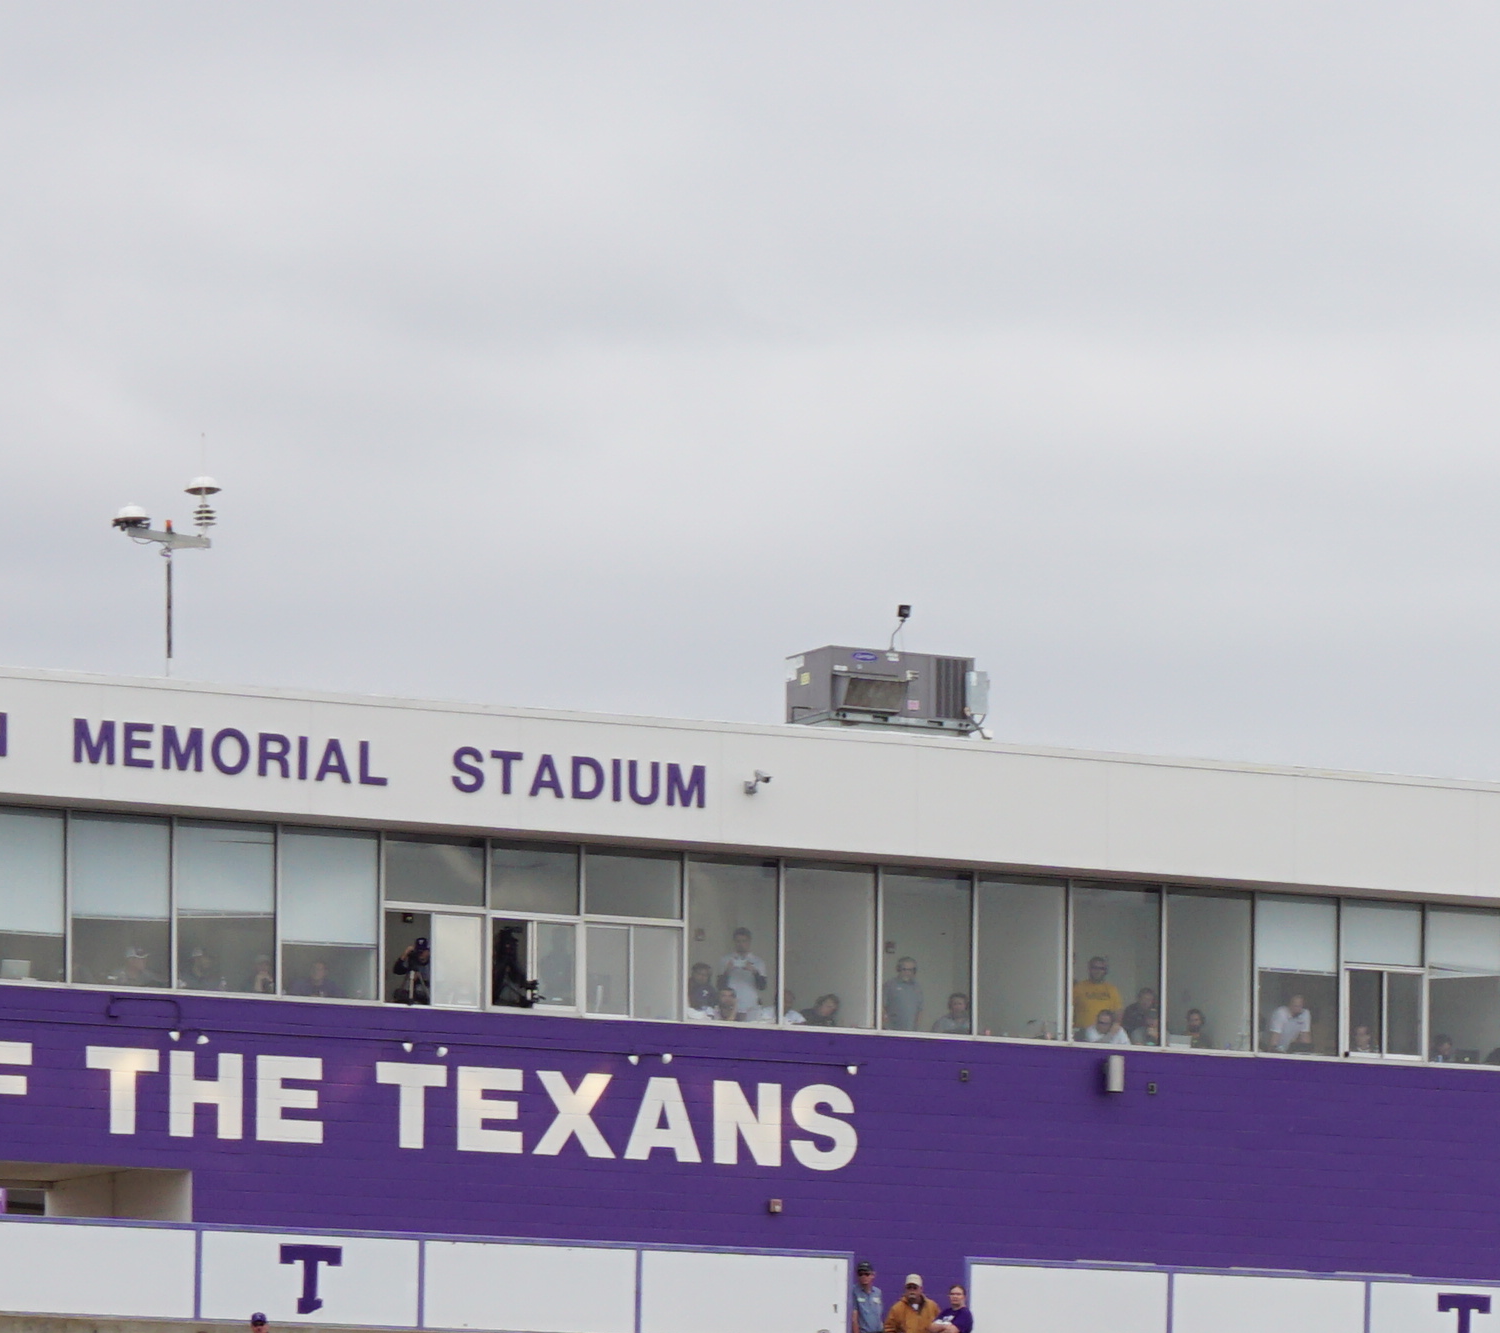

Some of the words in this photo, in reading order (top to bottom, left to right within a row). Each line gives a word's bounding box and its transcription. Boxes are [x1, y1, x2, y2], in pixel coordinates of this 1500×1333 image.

[71, 717, 388, 788] MEMORIAL
[451, 746, 707, 809] STADIUM
[87, 1047, 324, 1147] THE
[376, 1061, 859, 1173] TEXANS
[279, 1244, 343, 1315] T
